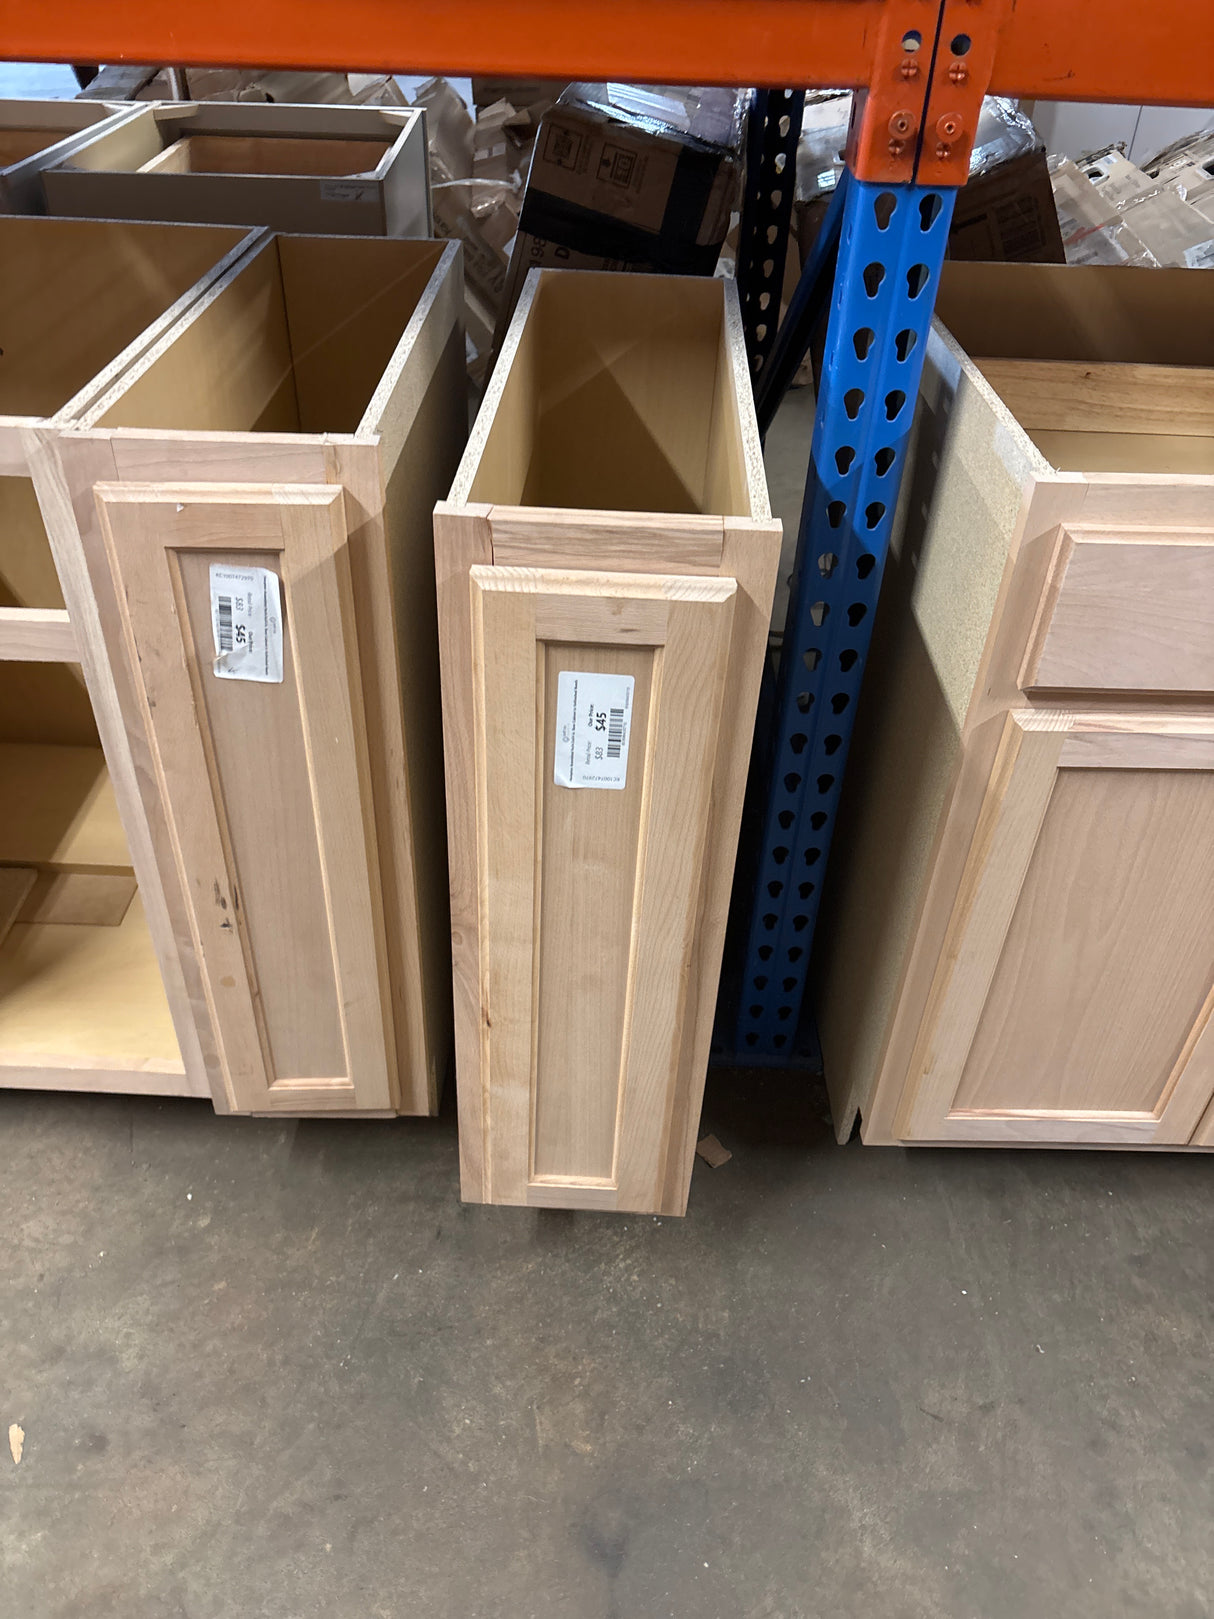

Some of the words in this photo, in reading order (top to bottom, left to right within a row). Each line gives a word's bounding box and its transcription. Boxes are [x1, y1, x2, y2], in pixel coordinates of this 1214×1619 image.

[235, 597, 244, 611] $83
[235, 624, 246, 644] $45
[595, 712, 607, 732] $45
[594, 747, 604, 760] $83
